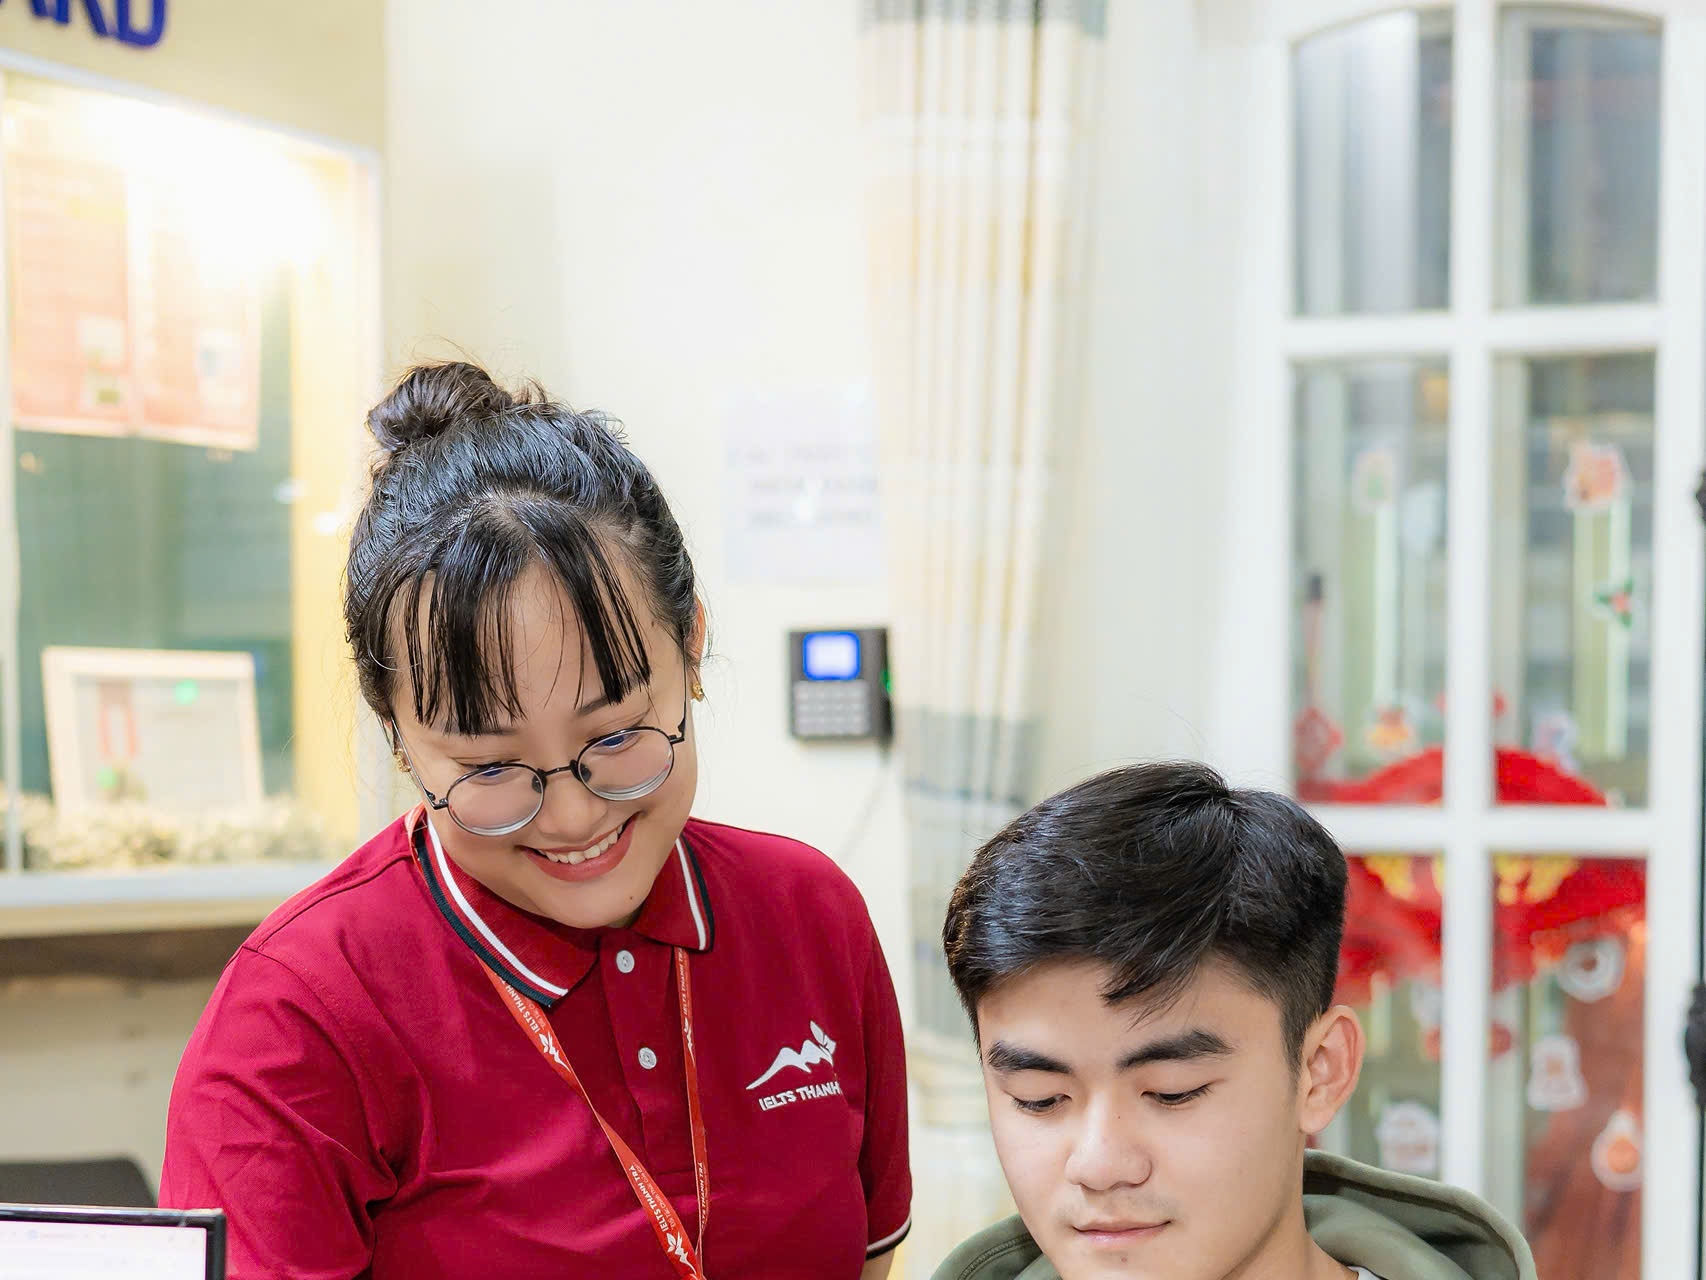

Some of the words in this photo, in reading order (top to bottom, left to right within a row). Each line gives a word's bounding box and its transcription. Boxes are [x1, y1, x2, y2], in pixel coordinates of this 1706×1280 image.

[505, 984, 527, 1013] THANH
[523, 1011, 540, 1033] IELTS
[759, 1090, 797, 1111] IELTS
[796, 1081, 842, 1101] THANH
[638, 1182, 657, 1209] THANH
[654, 1208, 669, 1232] IELTS
